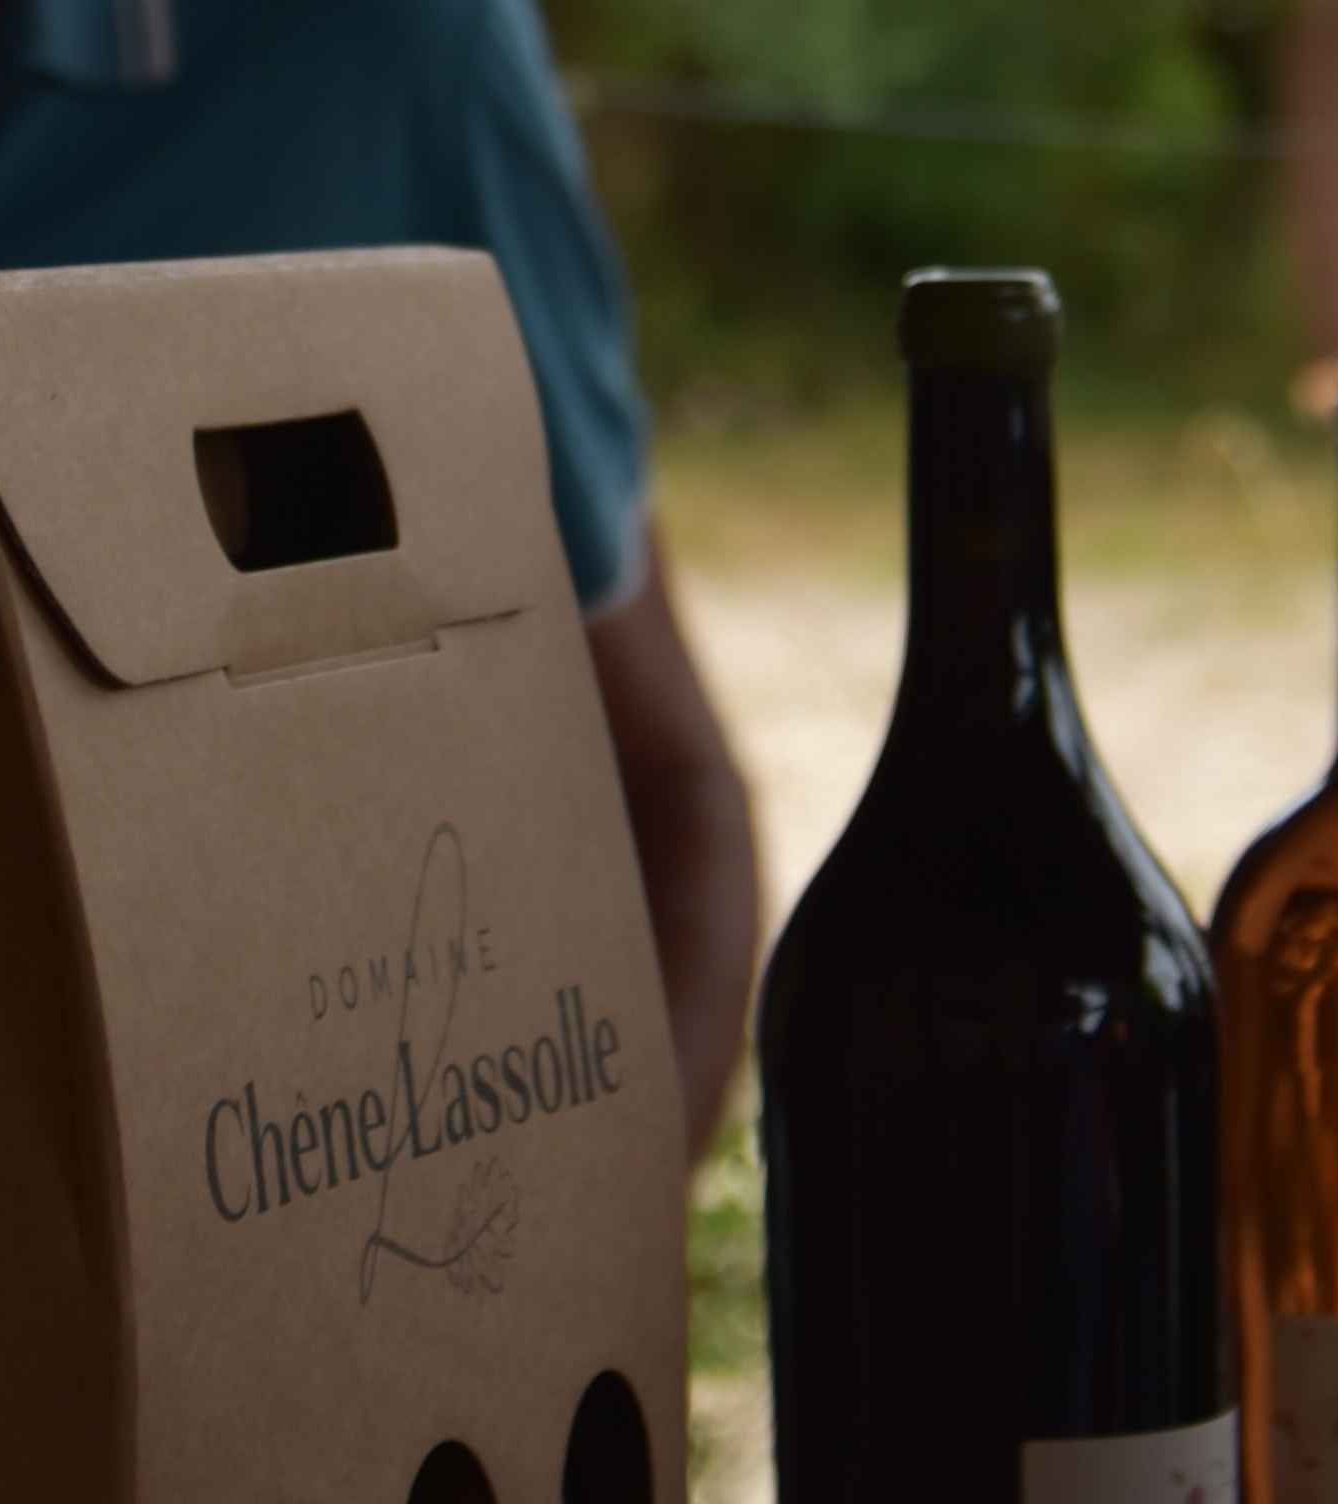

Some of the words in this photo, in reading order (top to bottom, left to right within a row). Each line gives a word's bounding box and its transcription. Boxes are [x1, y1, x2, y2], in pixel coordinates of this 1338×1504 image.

[308, 926, 499, 1022] DOMAINE
[204, 1079, 393, 1223] Chêne
[396, 985, 621, 1158] Lassolle
